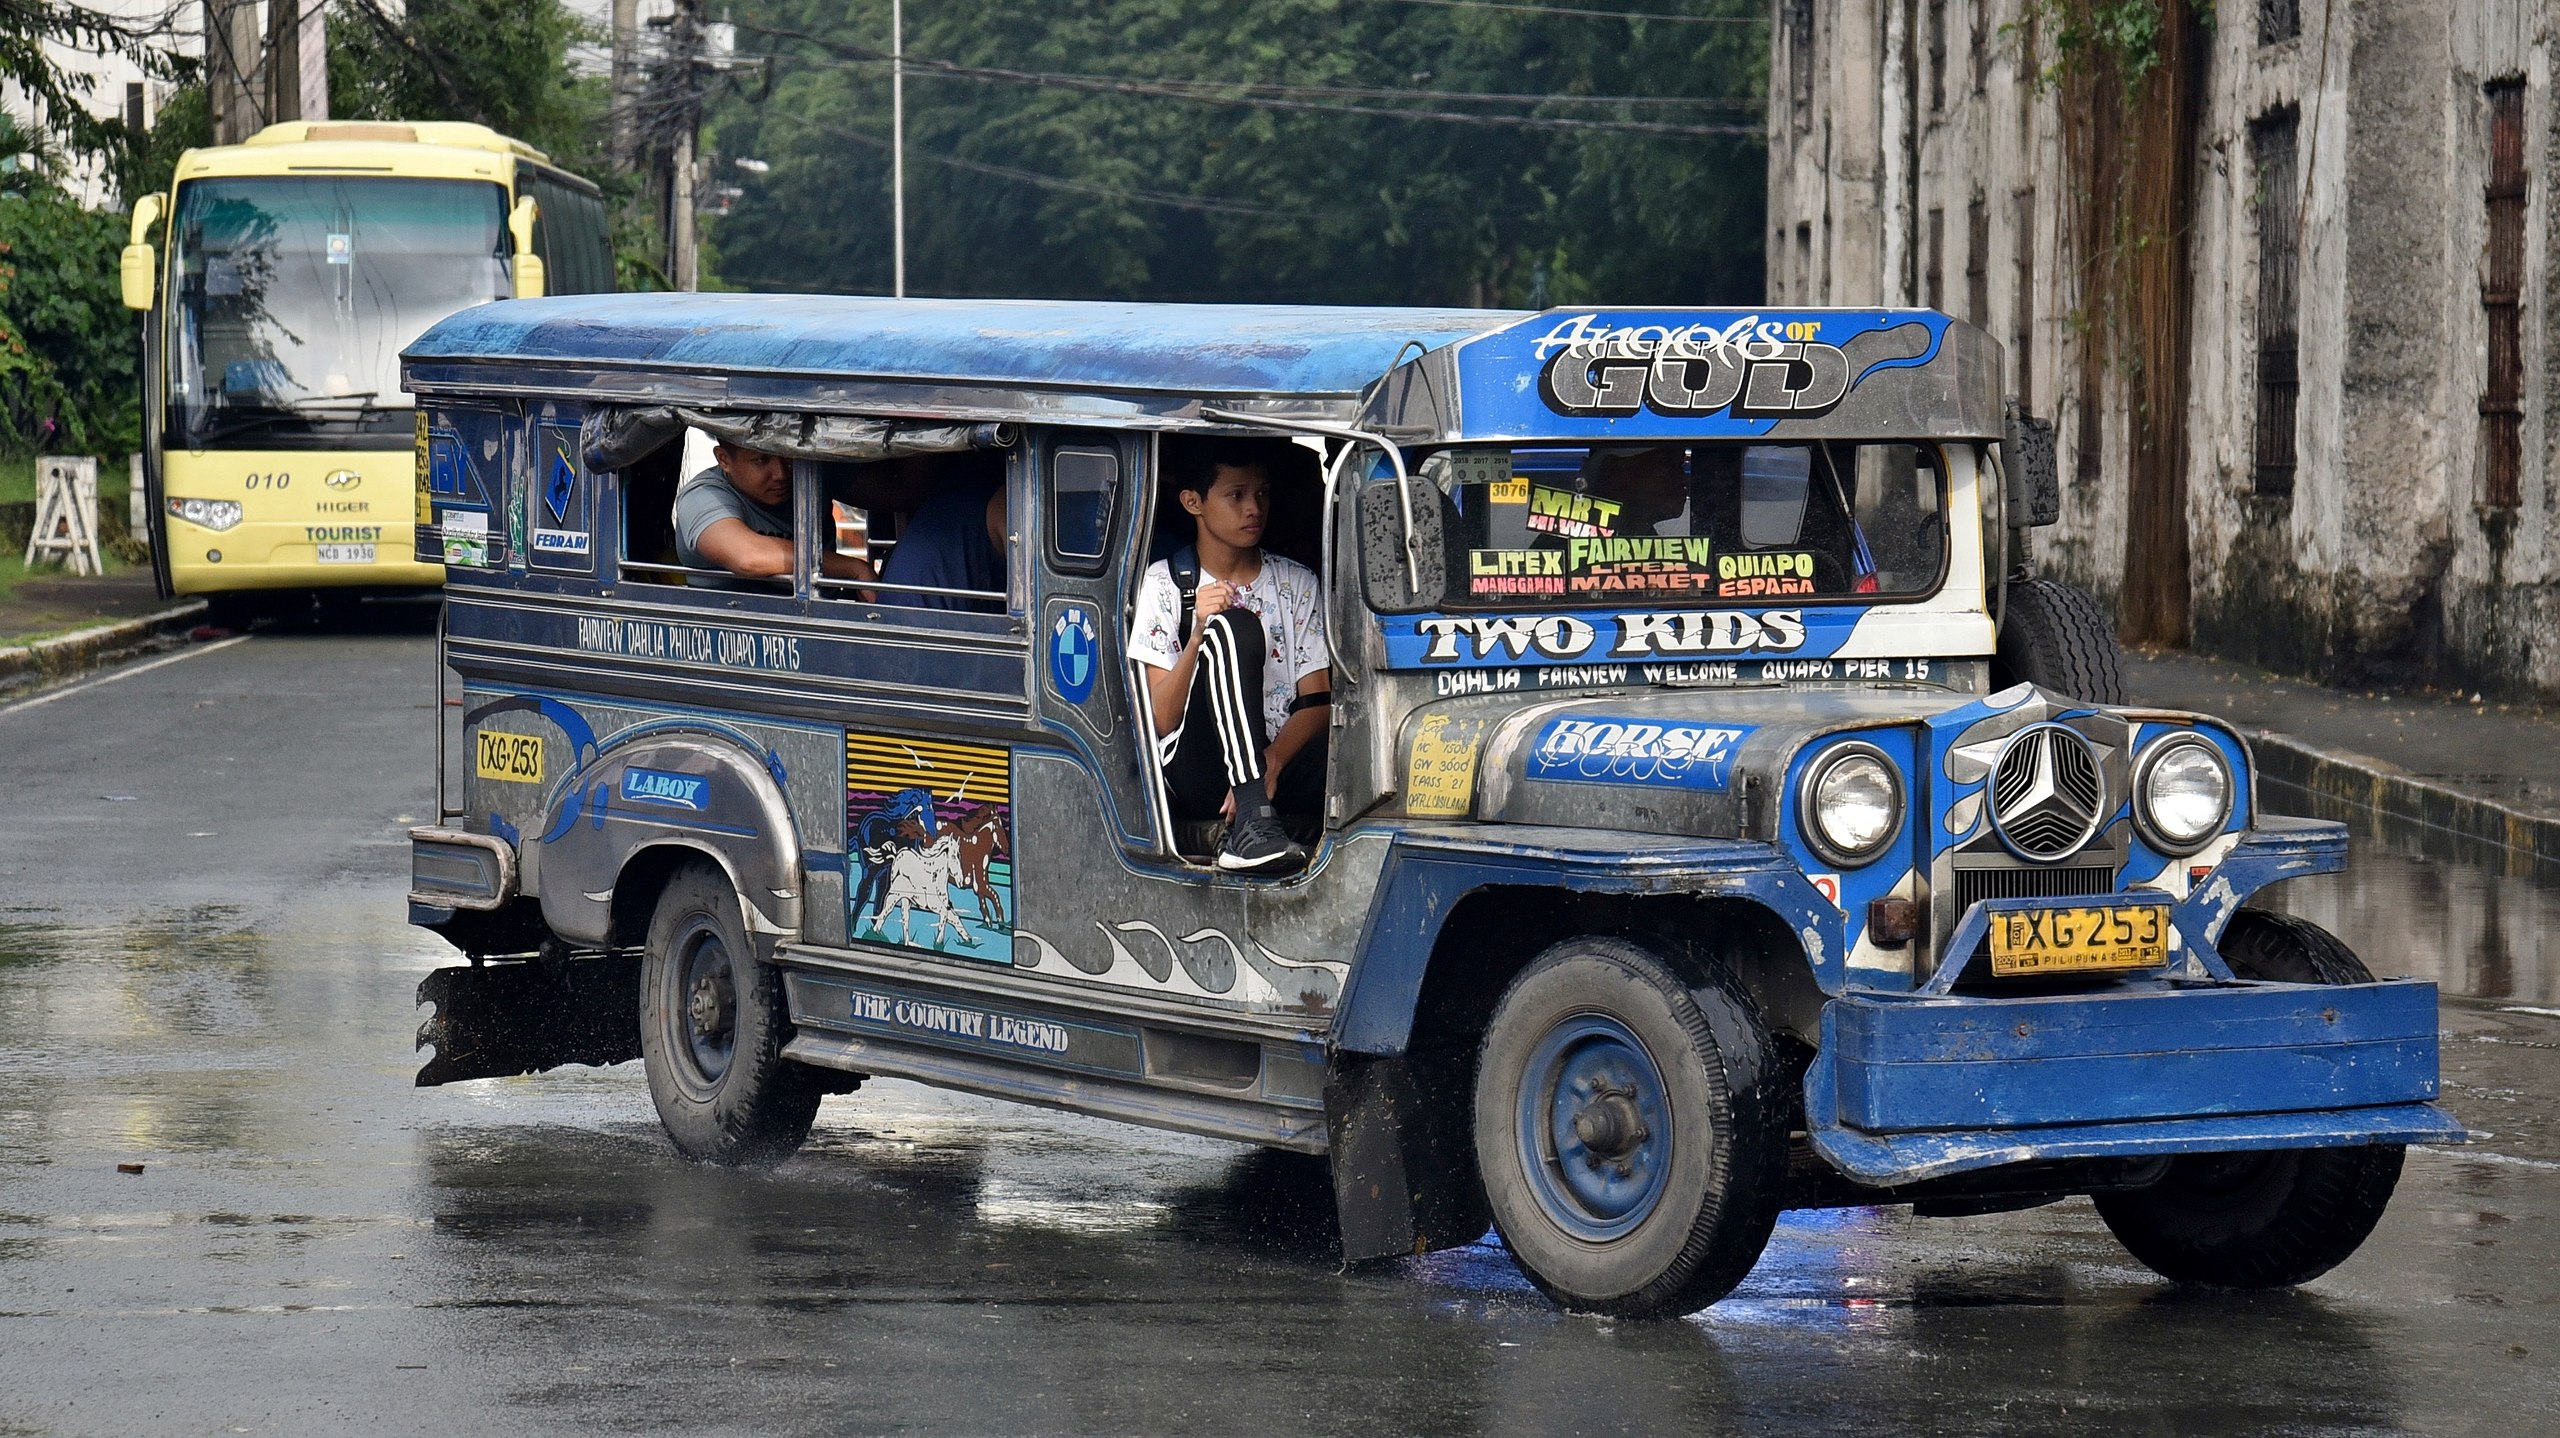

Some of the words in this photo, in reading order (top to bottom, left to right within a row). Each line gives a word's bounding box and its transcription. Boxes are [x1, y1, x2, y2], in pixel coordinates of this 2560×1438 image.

[1785, 321, 1821, 342] OF
[1545, 340, 1850, 415] GOD
[1473, 457, 1489, 465] 2017
[245, 472, 290, 489] 010
[1492, 484, 1527, 497] 3076
[316, 502, 370, 513] HIGER
[1530, 487, 1621, 528] MRT
[305, 526, 382, 541] TOURIST
[535, 533, 588, 549] FERRARI
[1472, 551, 1563, 575] LITEX
[1570, 537, 1710, 571] FAIRVIEW
[1591, 561, 1688, 575] LITEX
[1718, 553, 1814, 580] QUIAPO
[1571, 573, 1710, 590] MARKET
[1718, 577, 1815, 597] ESPAÑA
[1056, 609, 1095, 642] BMW
[1418, 615, 1596, 660] TWO
[1612, 609, 1807, 655] KIDS
[578, 616, 623, 654] FAIRVIEW
[627, 622, 665, 658] DAHLIA
[669, 627, 713, 663] PHILCOA
[718, 630, 756, 667] QUIAPO
[762, 635, 787, 670] PIER
[787, 637, 800, 671] 15
[1437, 668, 1521, 696] DAHLIA
[1538, 664, 1628, 687] FAIRVIEW
[1642, 660, 1738, 683] WELCOME
[1761, 659, 1834, 680] QUIAPO
[1845, 658, 1891, 679] PIER
[1905, 658, 1930, 680] 15
[1443, 743, 1469, 755] 1500
[1541, 719, 1744, 763] HORSE
[1413, 758, 1433, 771] GW
[1438, 760, 1469, 772] 3000
[629, 773, 701, 801] LABOY
[1998, 909, 2074, 950] TXG
[2084, 905, 2160, 946] 253
[2044, 952, 2118, 965] PILIPINAS
[851, 990, 891, 1022] THE
[895, 1000, 984, 1038] COUNTRY
[989, 1014, 1069, 1052] LEGEND
